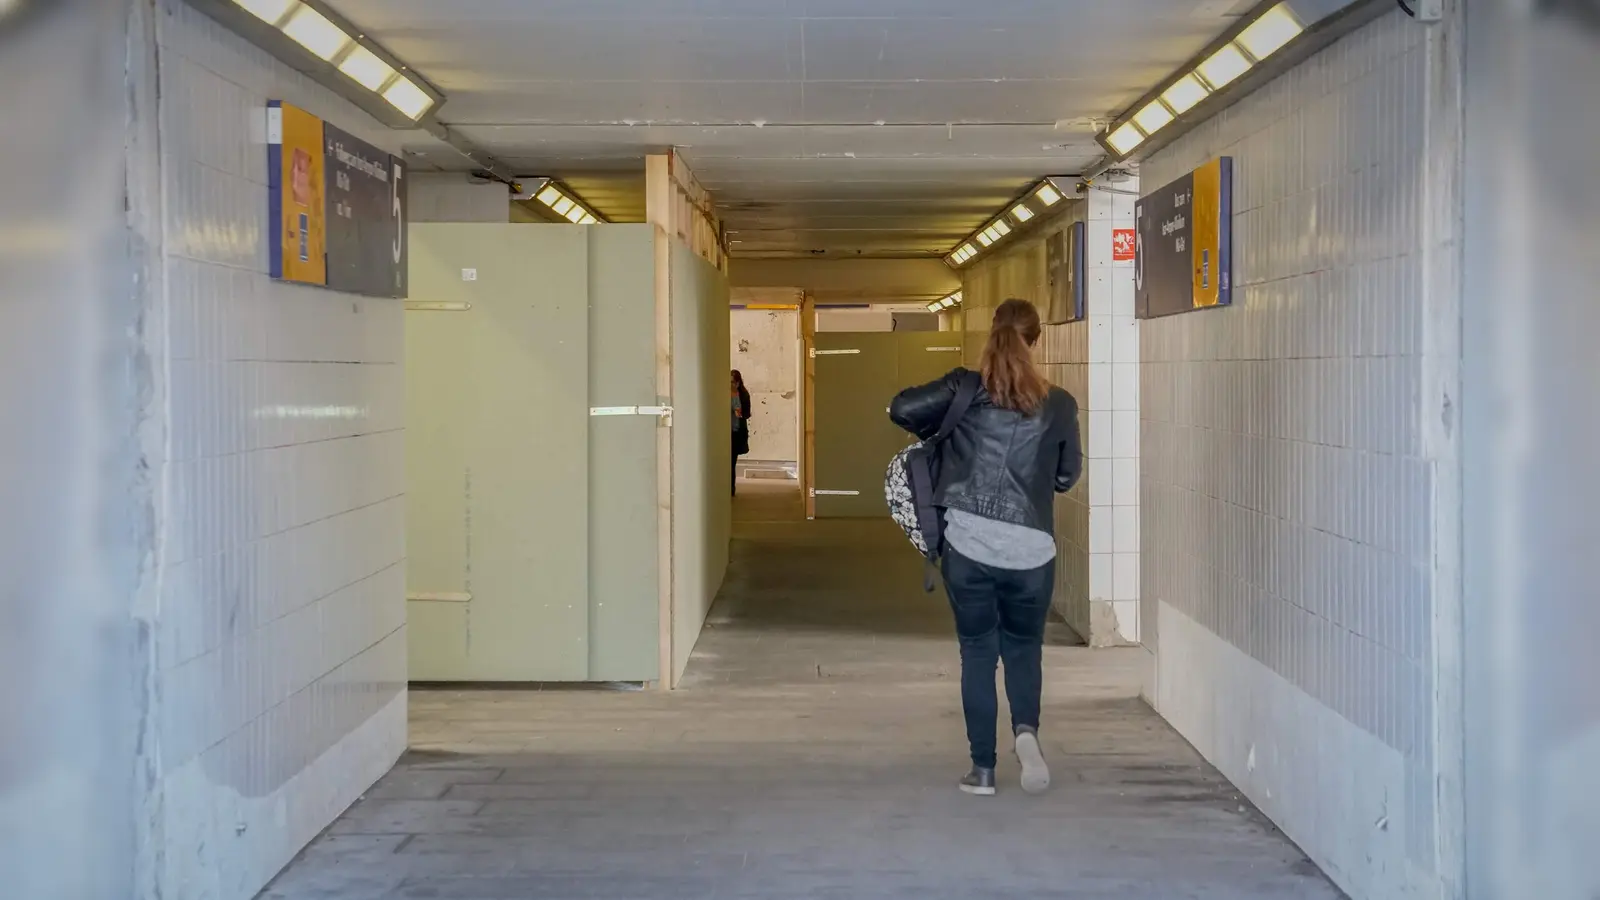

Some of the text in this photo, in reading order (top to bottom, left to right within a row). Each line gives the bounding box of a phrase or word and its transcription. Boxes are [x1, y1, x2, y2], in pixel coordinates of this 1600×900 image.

[392, 163, 402, 264] 5
[1136, 205, 1143, 291] 5
[1068, 229, 1073, 290] 4
